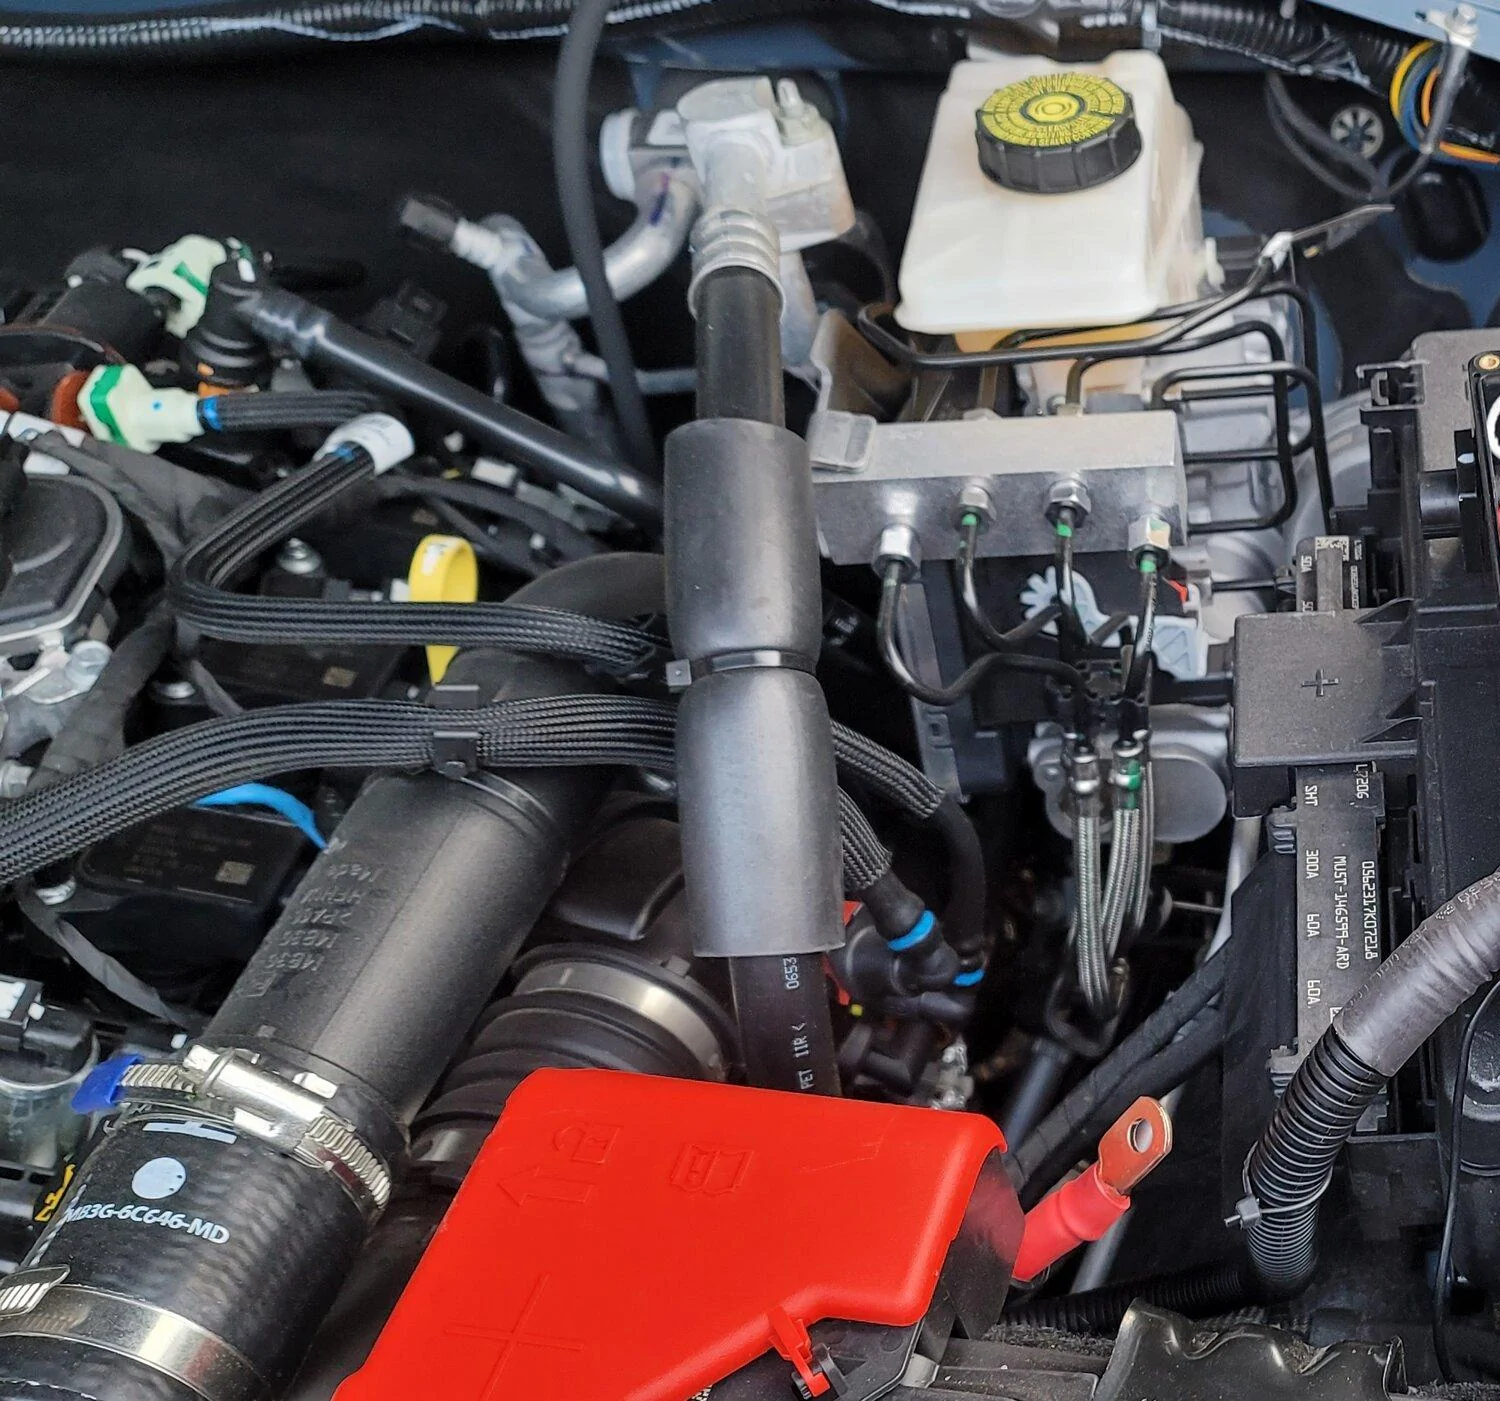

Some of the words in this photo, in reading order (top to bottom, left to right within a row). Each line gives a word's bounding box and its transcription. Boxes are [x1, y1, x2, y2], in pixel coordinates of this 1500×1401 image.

[1304, 785, 1319, 806] SHT
[1306, 849, 1319, 879] 300A
[1307, 913, 1321, 938] 60A
[783, 956, 800, 989] 0653
[798, 1069, 815, 1090] PET
